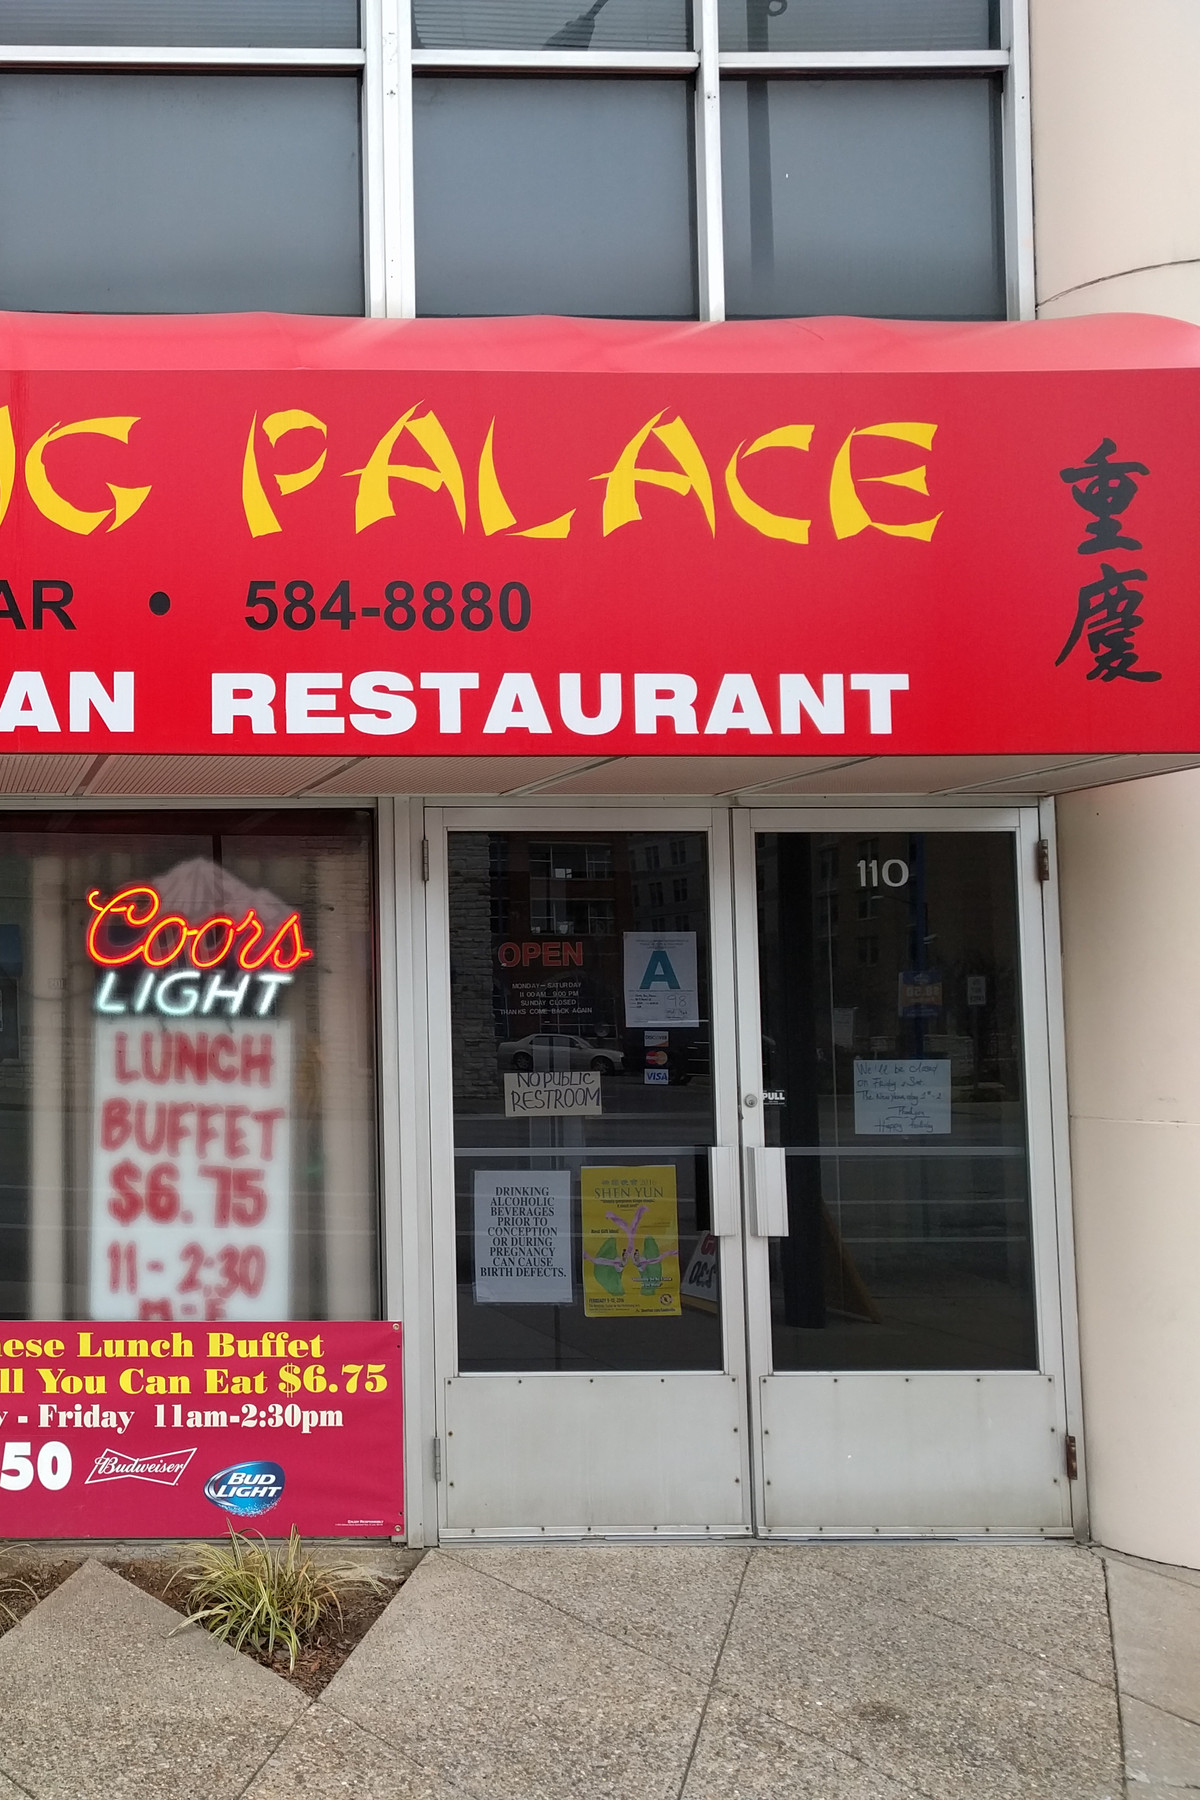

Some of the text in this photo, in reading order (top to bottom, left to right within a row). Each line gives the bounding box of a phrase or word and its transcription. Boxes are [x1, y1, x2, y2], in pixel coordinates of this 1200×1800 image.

[242, 401, 944, 544] PALACE
[245, 581, 531, 631] 584-8880
[212, 671, 910, 735] RESTAURANT
[857, 859, 910, 888] 110
[86, 882, 313, 970] Coors
[498, 941, 583, 967] OPEN
[639, 950, 681, 990] A
[96, 970, 293, 1015] LIGHT
[113, 1031, 275, 1088] LUNCH
[517, 1072, 541, 1087] NO
[646, 1072, 668, 1081] VISA
[511, 1087, 600, 1112] RESTROOM
[763, 1092, 785, 1100] PULL
[100, 1097, 285, 1162] BUFFET
[107, 1158, 269, 1229] $6.75
[495, 1187, 549, 1196] DRINKING
[594, 1186, 664, 1199] SHEN YUN
[490, 1197, 555, 1206] ALCOHOLIC
[490, 1207, 555, 1216] BEVERAGES
[497, 1217, 548, 1226] PRIOR TO
[487, 1227, 558, 1236] CONCEPTION
[492, 1237, 553, 1247] OR DURING
[490, 1247, 555, 1257] PREGNANCY
[492, 1257, 553, 1267] CAN CAUSE
[480, 1267, 567, 1278] BIRTH DEFECTS.
[77, 1332, 194, 1358] Lunch
[206, 1331, 324, 1358] Buffet
[37, 1368, 107, 1395] You
[119, 1368, 192, 1395] Can
[203, 1368, 268, 1395] Eat
[278, 1363, 388, 1398] $6.75
[38, 1403, 135, 1434] Friday
[154, 1403, 344, 1434] 11am-2:30pm
[94, 1456, 185, 1475] Budweiser
[227, 1472, 276, 1486] BUD
[216, 1485, 283, 1498] LIGHT
